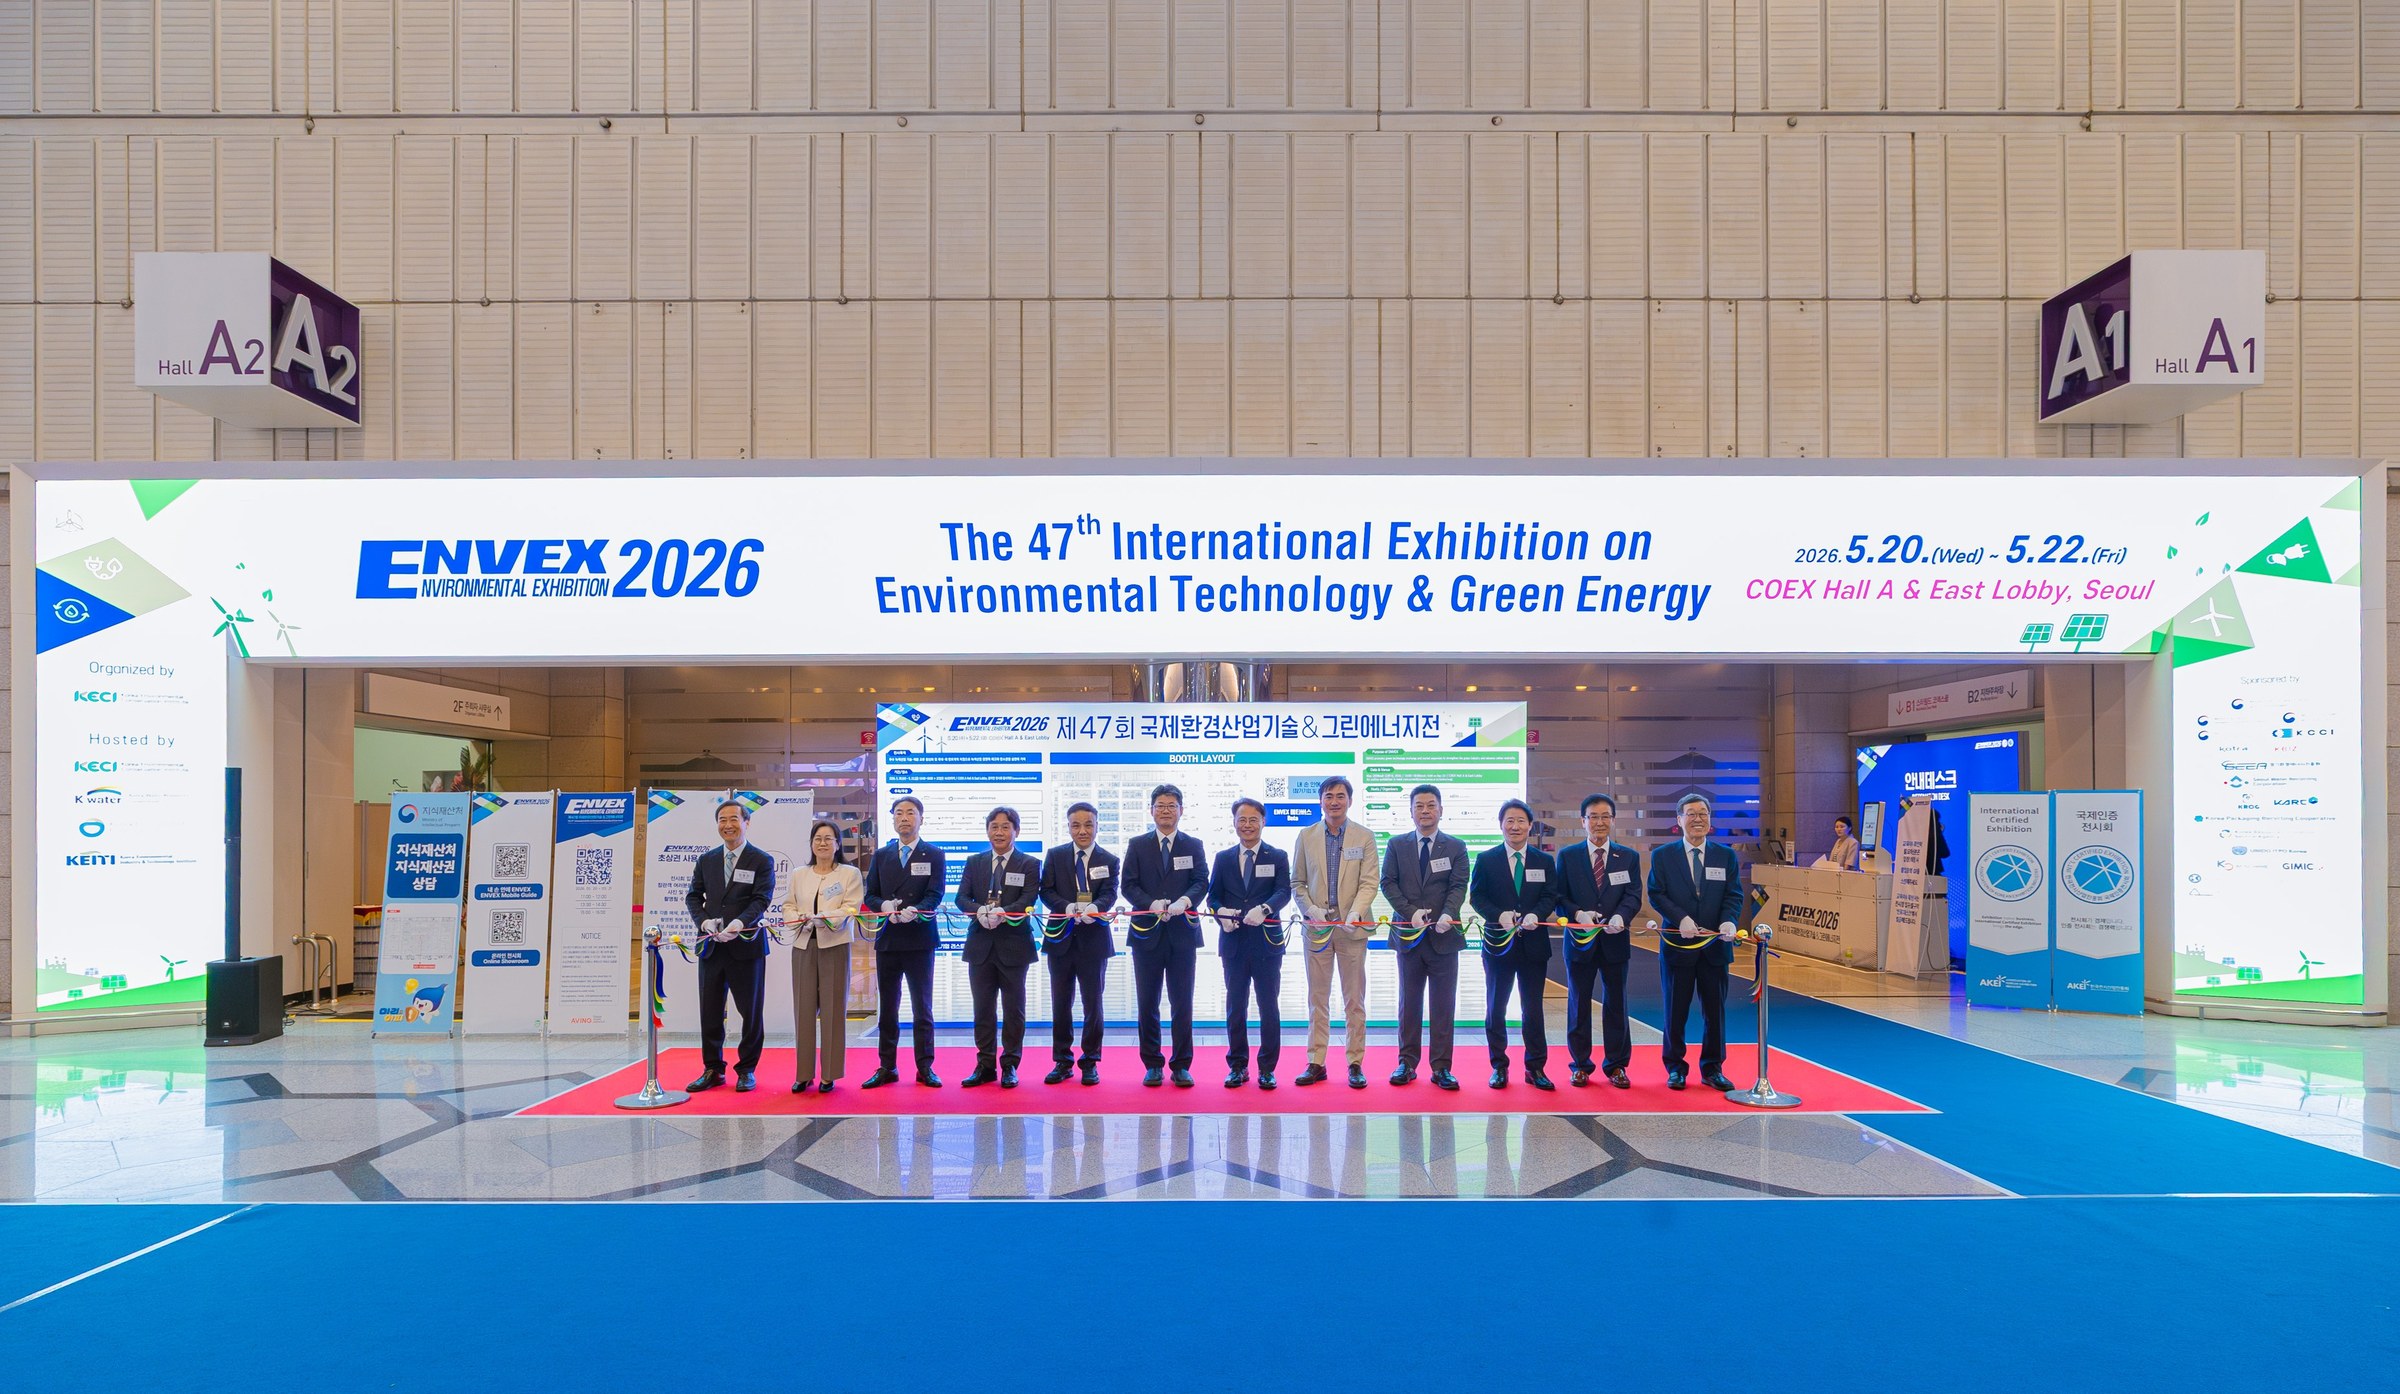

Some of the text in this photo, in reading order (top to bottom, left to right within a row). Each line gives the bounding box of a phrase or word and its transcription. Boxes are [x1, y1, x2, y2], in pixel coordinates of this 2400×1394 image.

[158, 319, 265, 375] Hall A2
[273, 293, 357, 405] A2
[2047, 302, 2125, 400] A1
[2155, 317, 2255, 374] Hall A1
[939, 513, 1653, 561] The 47th International Exhibition on
[355, 538, 765, 600] ENVEX 2026
[532, 577, 610, 597] EXHIBITION
[1746, 579, 2157, 606] COEX Hall A & East Lobby, Seoul
[875, 573, 1712, 621] Environmental Technology & Green Energy
[89, 661, 175, 679] Organized by
[74, 690, 118, 703] KECI
[1967, 690, 1979, 704] B2
[453, 700, 463, 713] 2F
[1905, 700, 1916, 713] B1
[948, 716, 1050, 732] ENVEX 2026
[89, 733, 175, 748] Hosted by
[1169, 754, 1236, 763] BOOTH LAYOUT
[74, 761, 118, 773] KECI
[1904, 769, 1957, 791] 안내데스크
[564, 798, 627, 814] ENVEX
[1980, 807, 2040, 815] International
[1989, 816, 2029, 824] Certified
[2075, 810, 2119, 821] 국제인증
[1986, 825, 2032, 833] Exhibition
[2081, 822, 2113, 832] 전시회
[396, 843, 457, 857] 지식재산처
[664, 845, 693, 853] ENVEX
[395, 860, 455, 874] 지식재산권
[2282, 862, 2314, 871] GIMIC
[412, 876, 438, 891] 상담
[1778, 904, 1841, 930] ENVEX 2026
[581, 932, 602, 940] NOTICE
[1980, 977, 2002, 988] AKEI
[2067, 981, 2087, 990] AKEI
